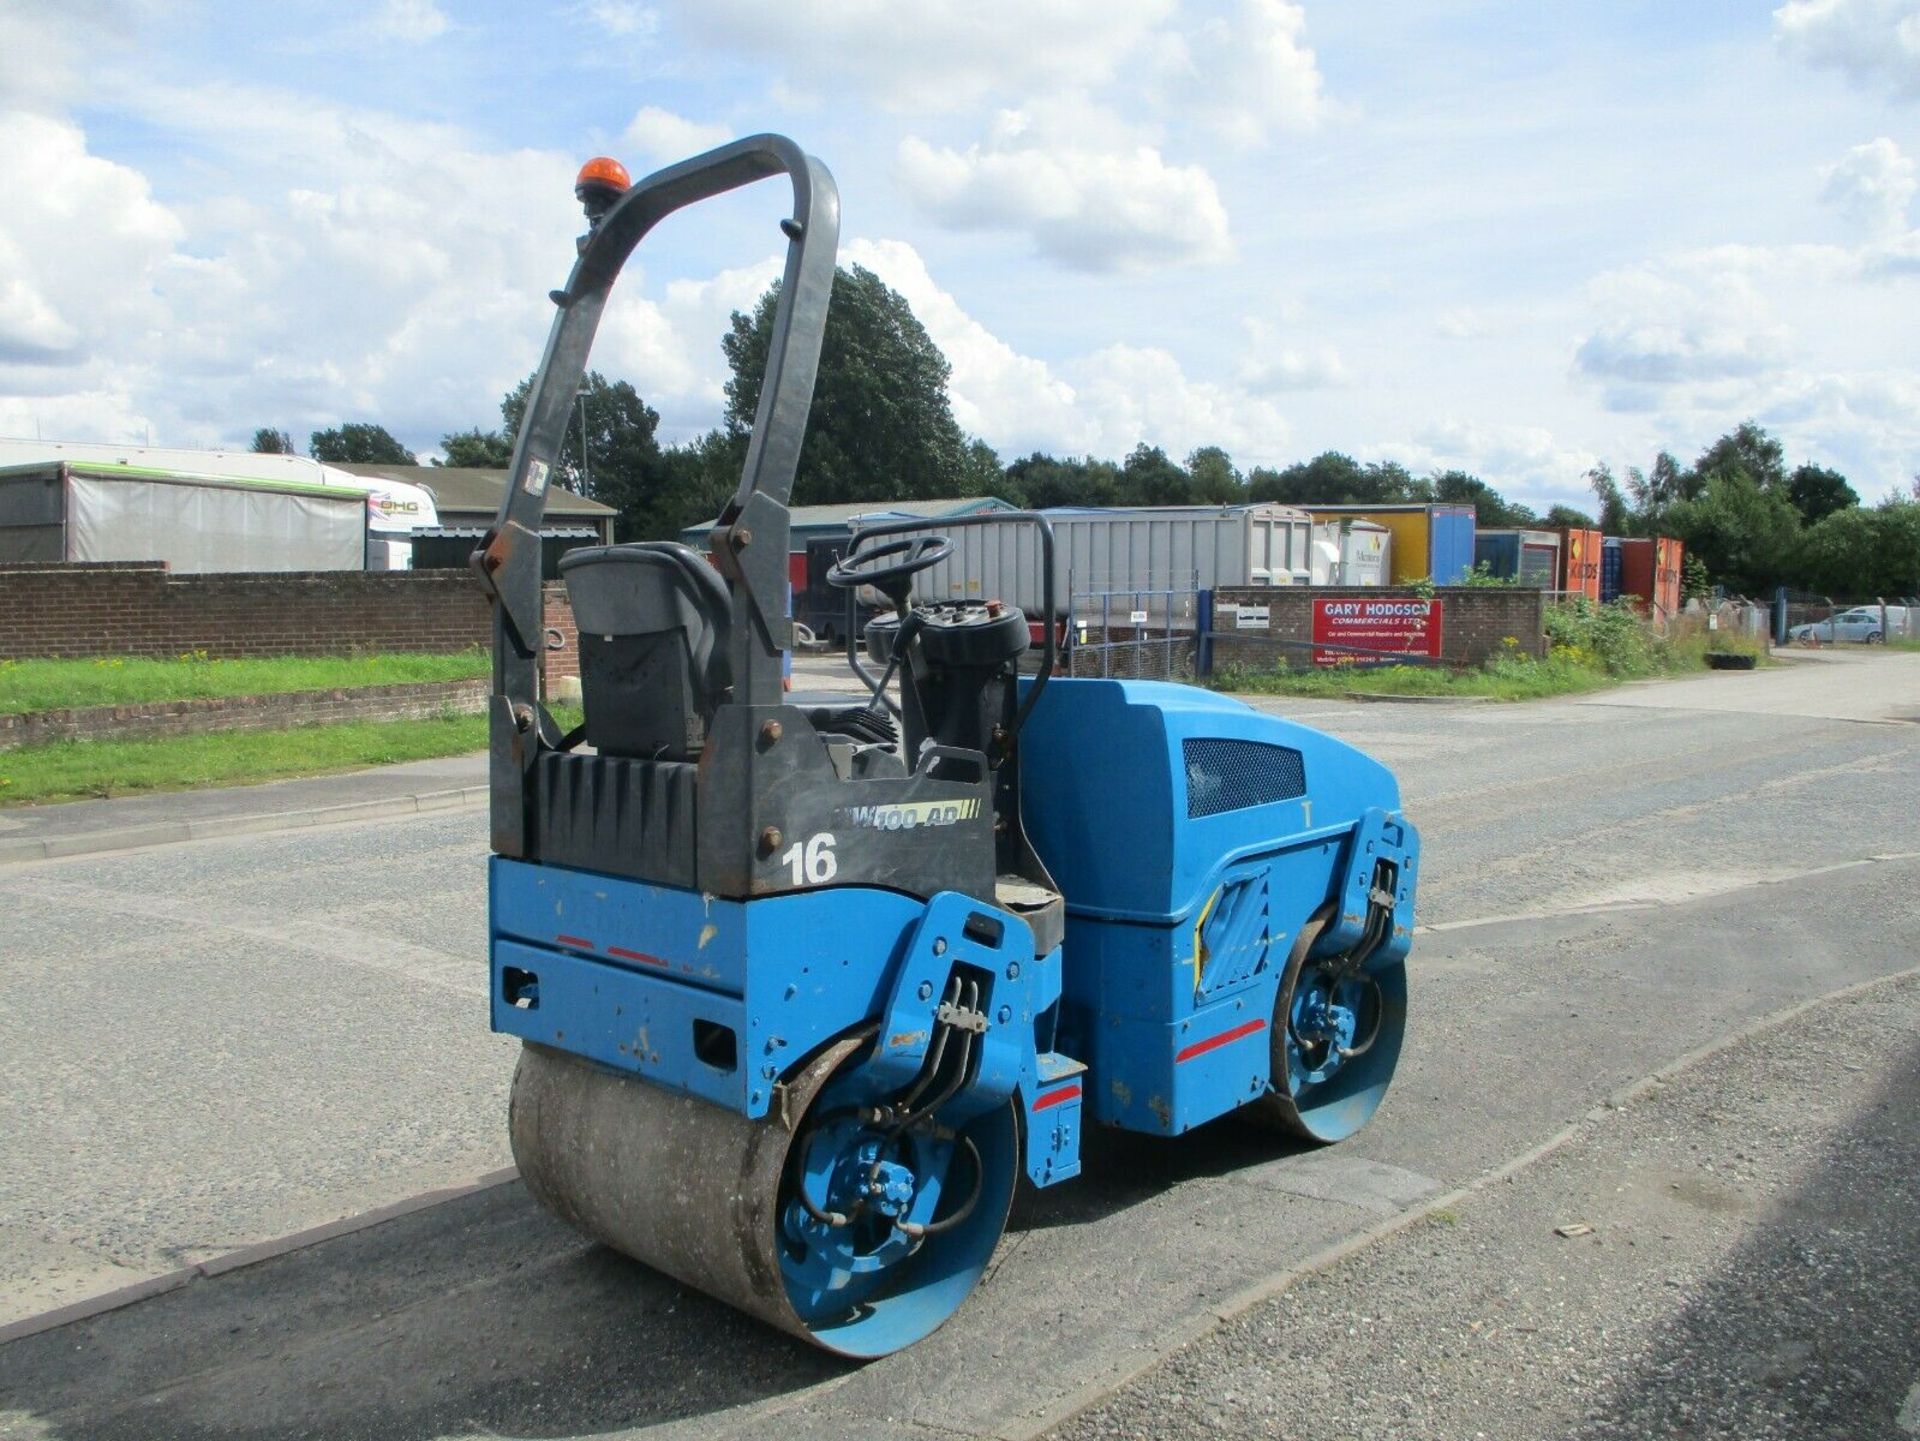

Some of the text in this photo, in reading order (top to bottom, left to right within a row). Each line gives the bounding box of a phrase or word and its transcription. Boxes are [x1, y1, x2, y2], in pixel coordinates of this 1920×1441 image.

[1325, 603, 1431, 616] GARY HODGSON
[1332, 617, 1401, 625] COMMERCIALS
[783, 832, 837, 886] 16
